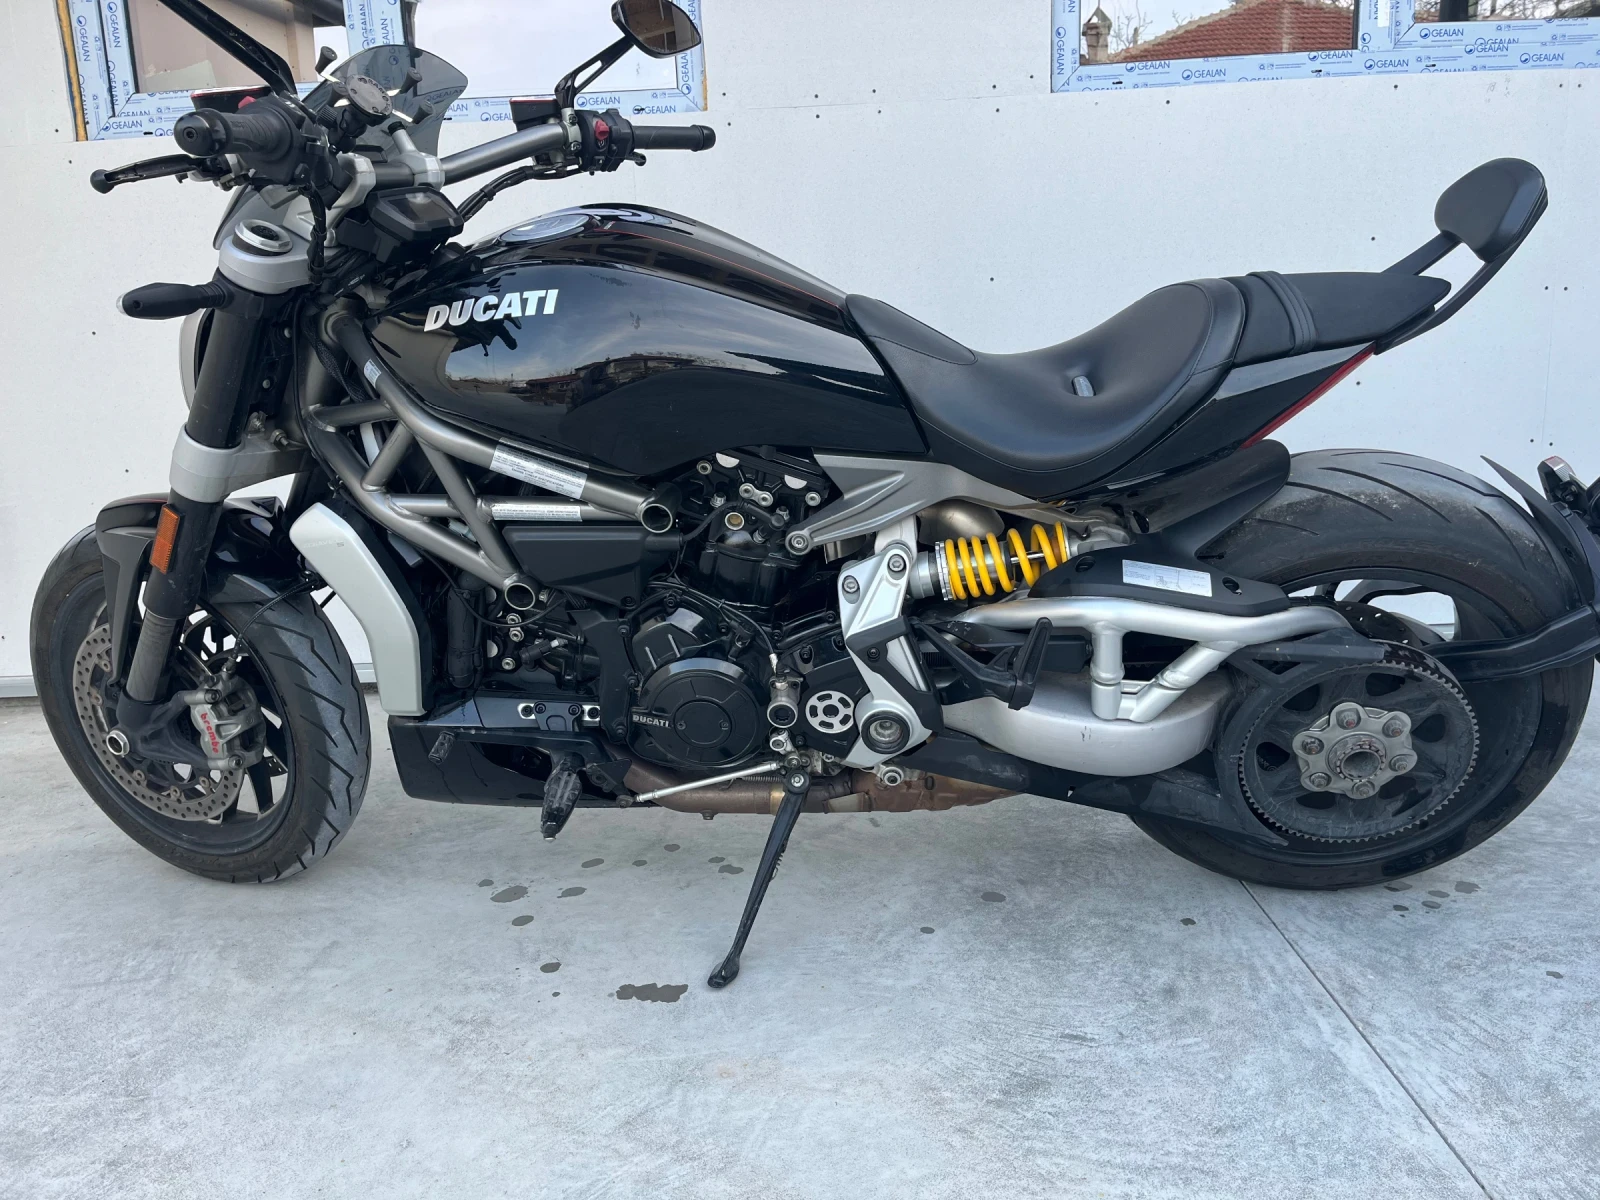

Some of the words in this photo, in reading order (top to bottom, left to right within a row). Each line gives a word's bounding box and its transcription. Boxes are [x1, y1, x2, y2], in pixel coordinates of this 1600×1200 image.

[110, 14, 122, 48] GEALAN
[1431, 28, 1464, 38] GEALAN
[80, 28, 91, 62] GEALAN
[1476, 44, 1509, 52] GEALAN
[1057, 40, 1065, 75] GEALAN
[1320, 51, 1353, 59] GEALAN
[1531, 53, 1565, 62] GEALAN
[1137, 61, 1170, 70] GEALAN
[1375, 60, 1409, 68] GEALAN
[1193, 69, 1227, 78] GEALAN
[588, 96, 620, 106] GEALAN
[447, 103, 468, 112] ALAN
[644, 105, 676, 115] GEALAN
[112, 120, 143, 129] GEALAN
[424, 289, 559, 332] DUCATI
[632, 714, 670, 728] DUCATI
[200, 712, 219, 754] brembo
